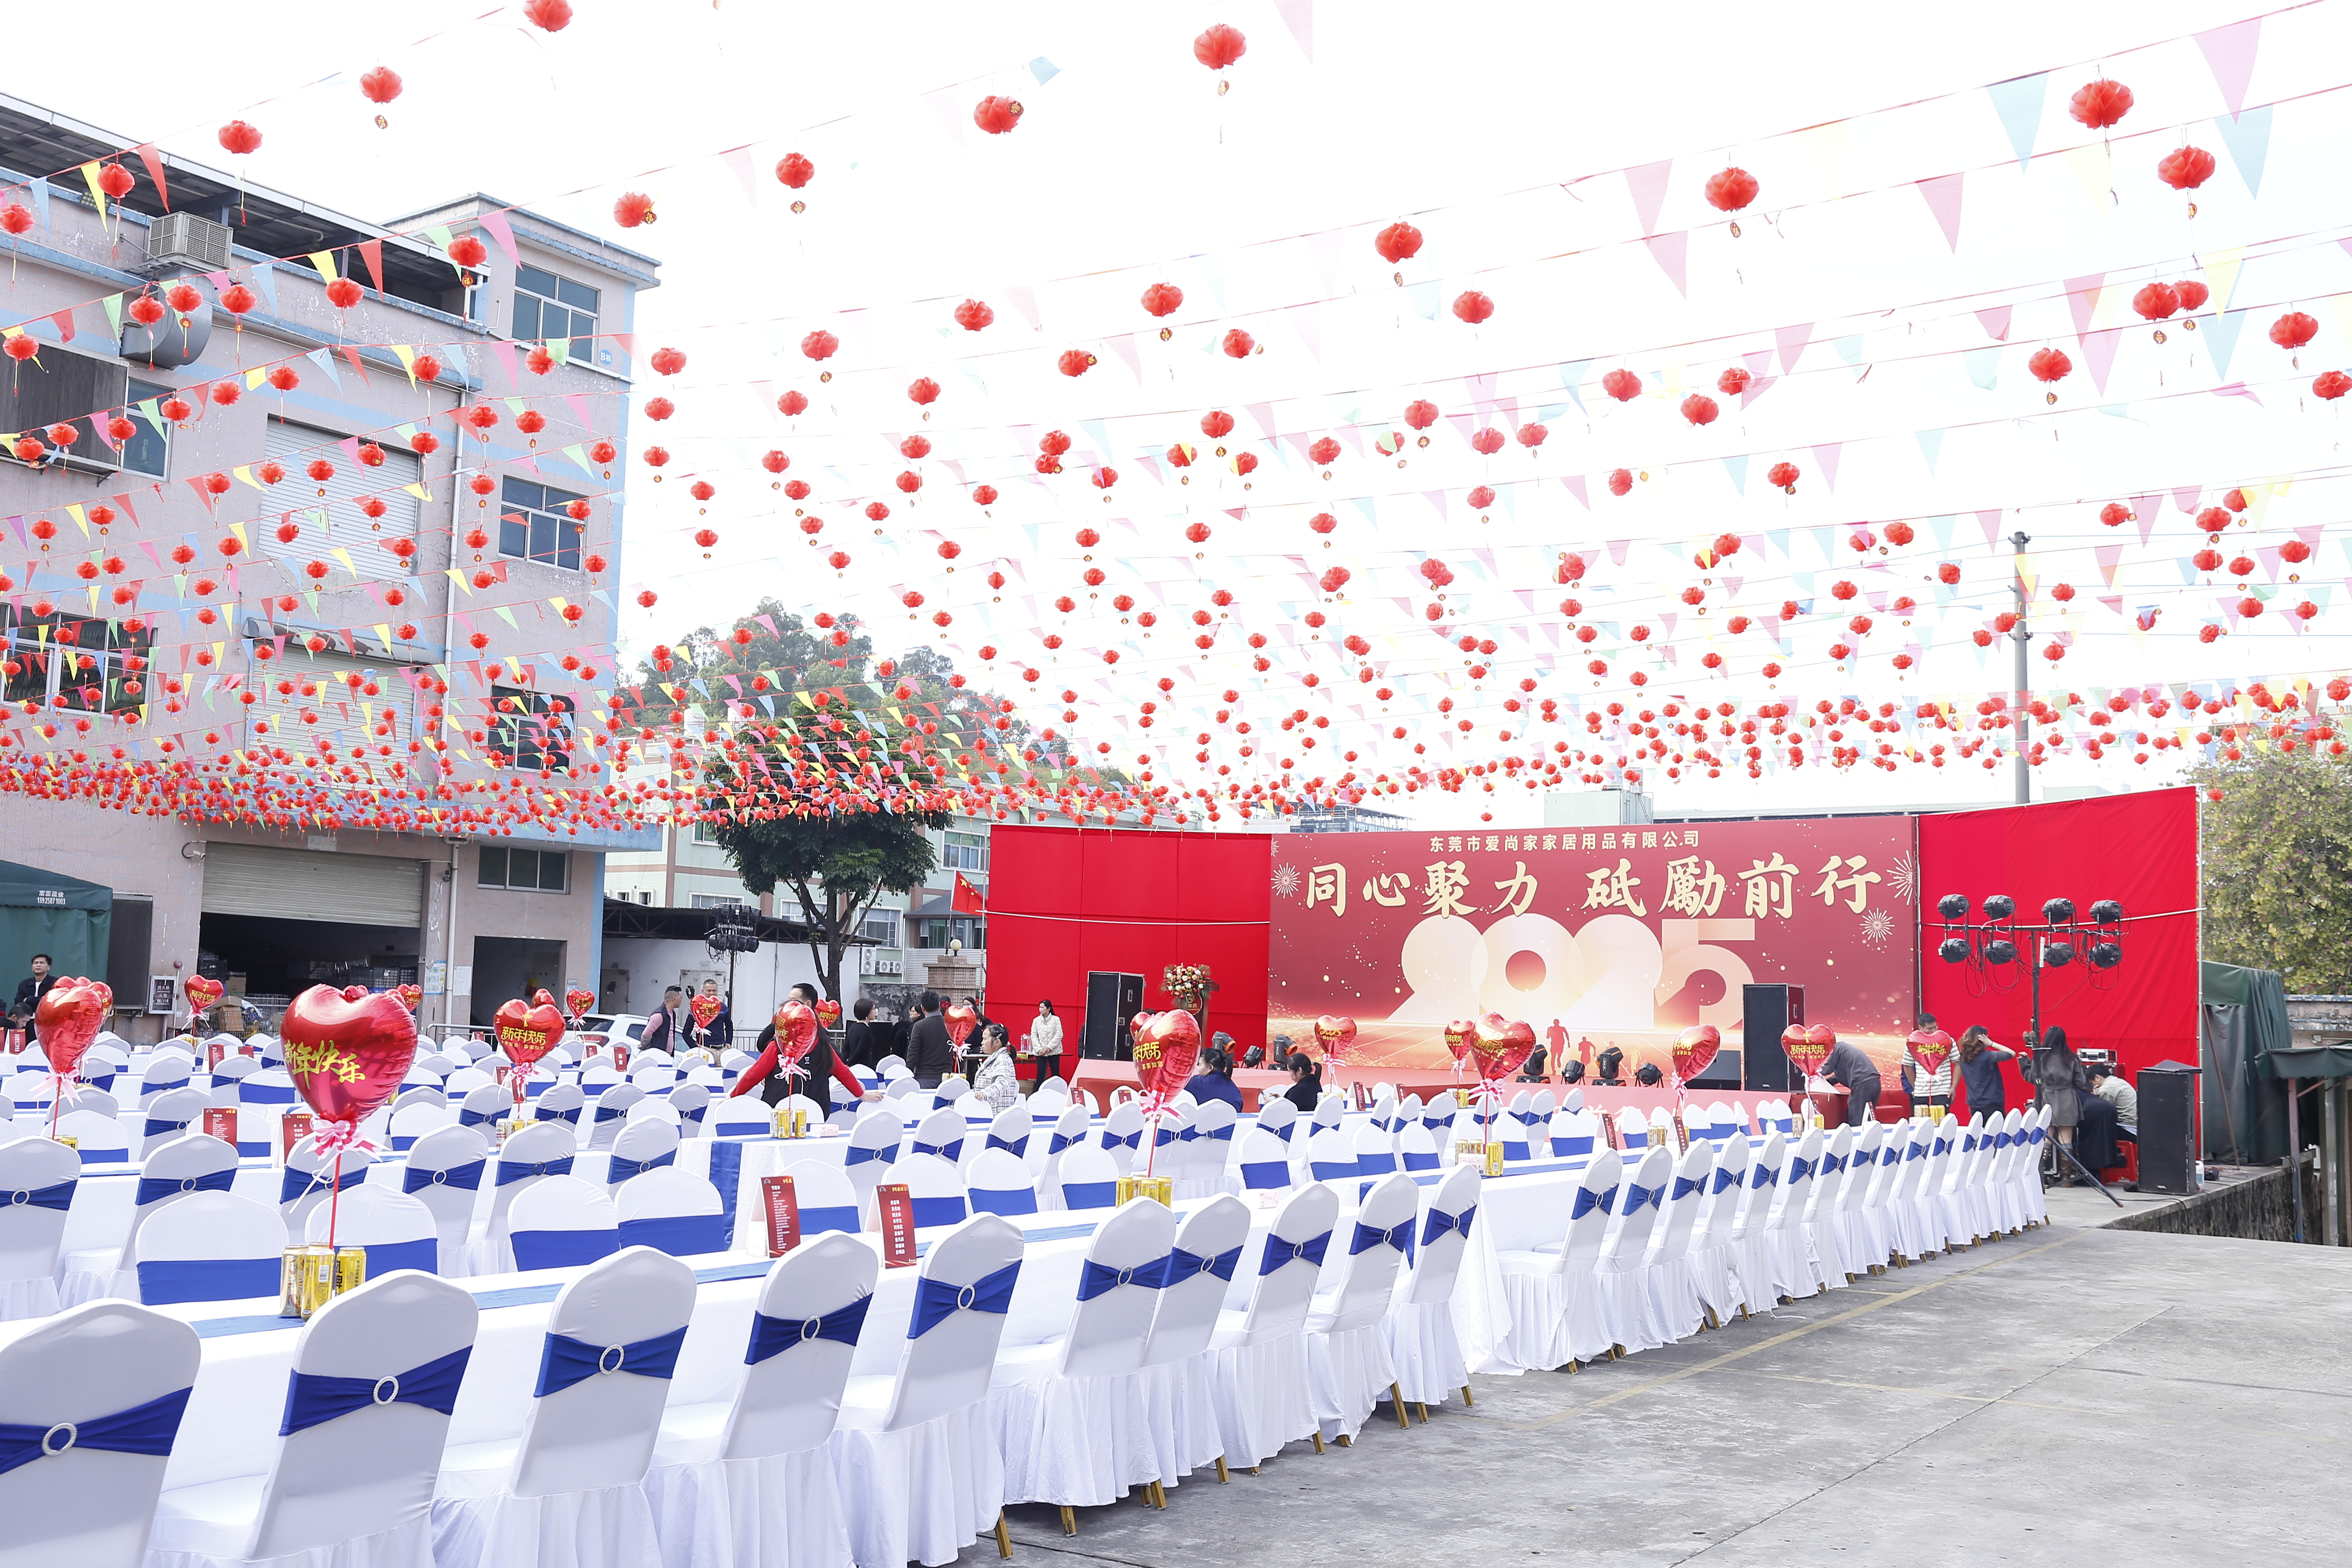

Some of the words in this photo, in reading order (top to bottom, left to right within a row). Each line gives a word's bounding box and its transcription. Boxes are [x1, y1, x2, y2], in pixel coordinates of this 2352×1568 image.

[601, 352, 611, 362] B栋
[1430, 830, 1699, 853] 东莞市爱尚家家居用品有限公司
[1306, 860, 1538, 918] 同心聚力
[1384, 913, 1755, 1032] 2025
[501, 1026, 546, 1045] 新年快乐
[1133, 1041, 1161, 1062] 年快乐
[1790, 1044, 1825, 1055] 新年快乐
[1916, 1042, 1946, 1059] 新年快乐
[284, 1039, 365, 1090] 新年快乐
